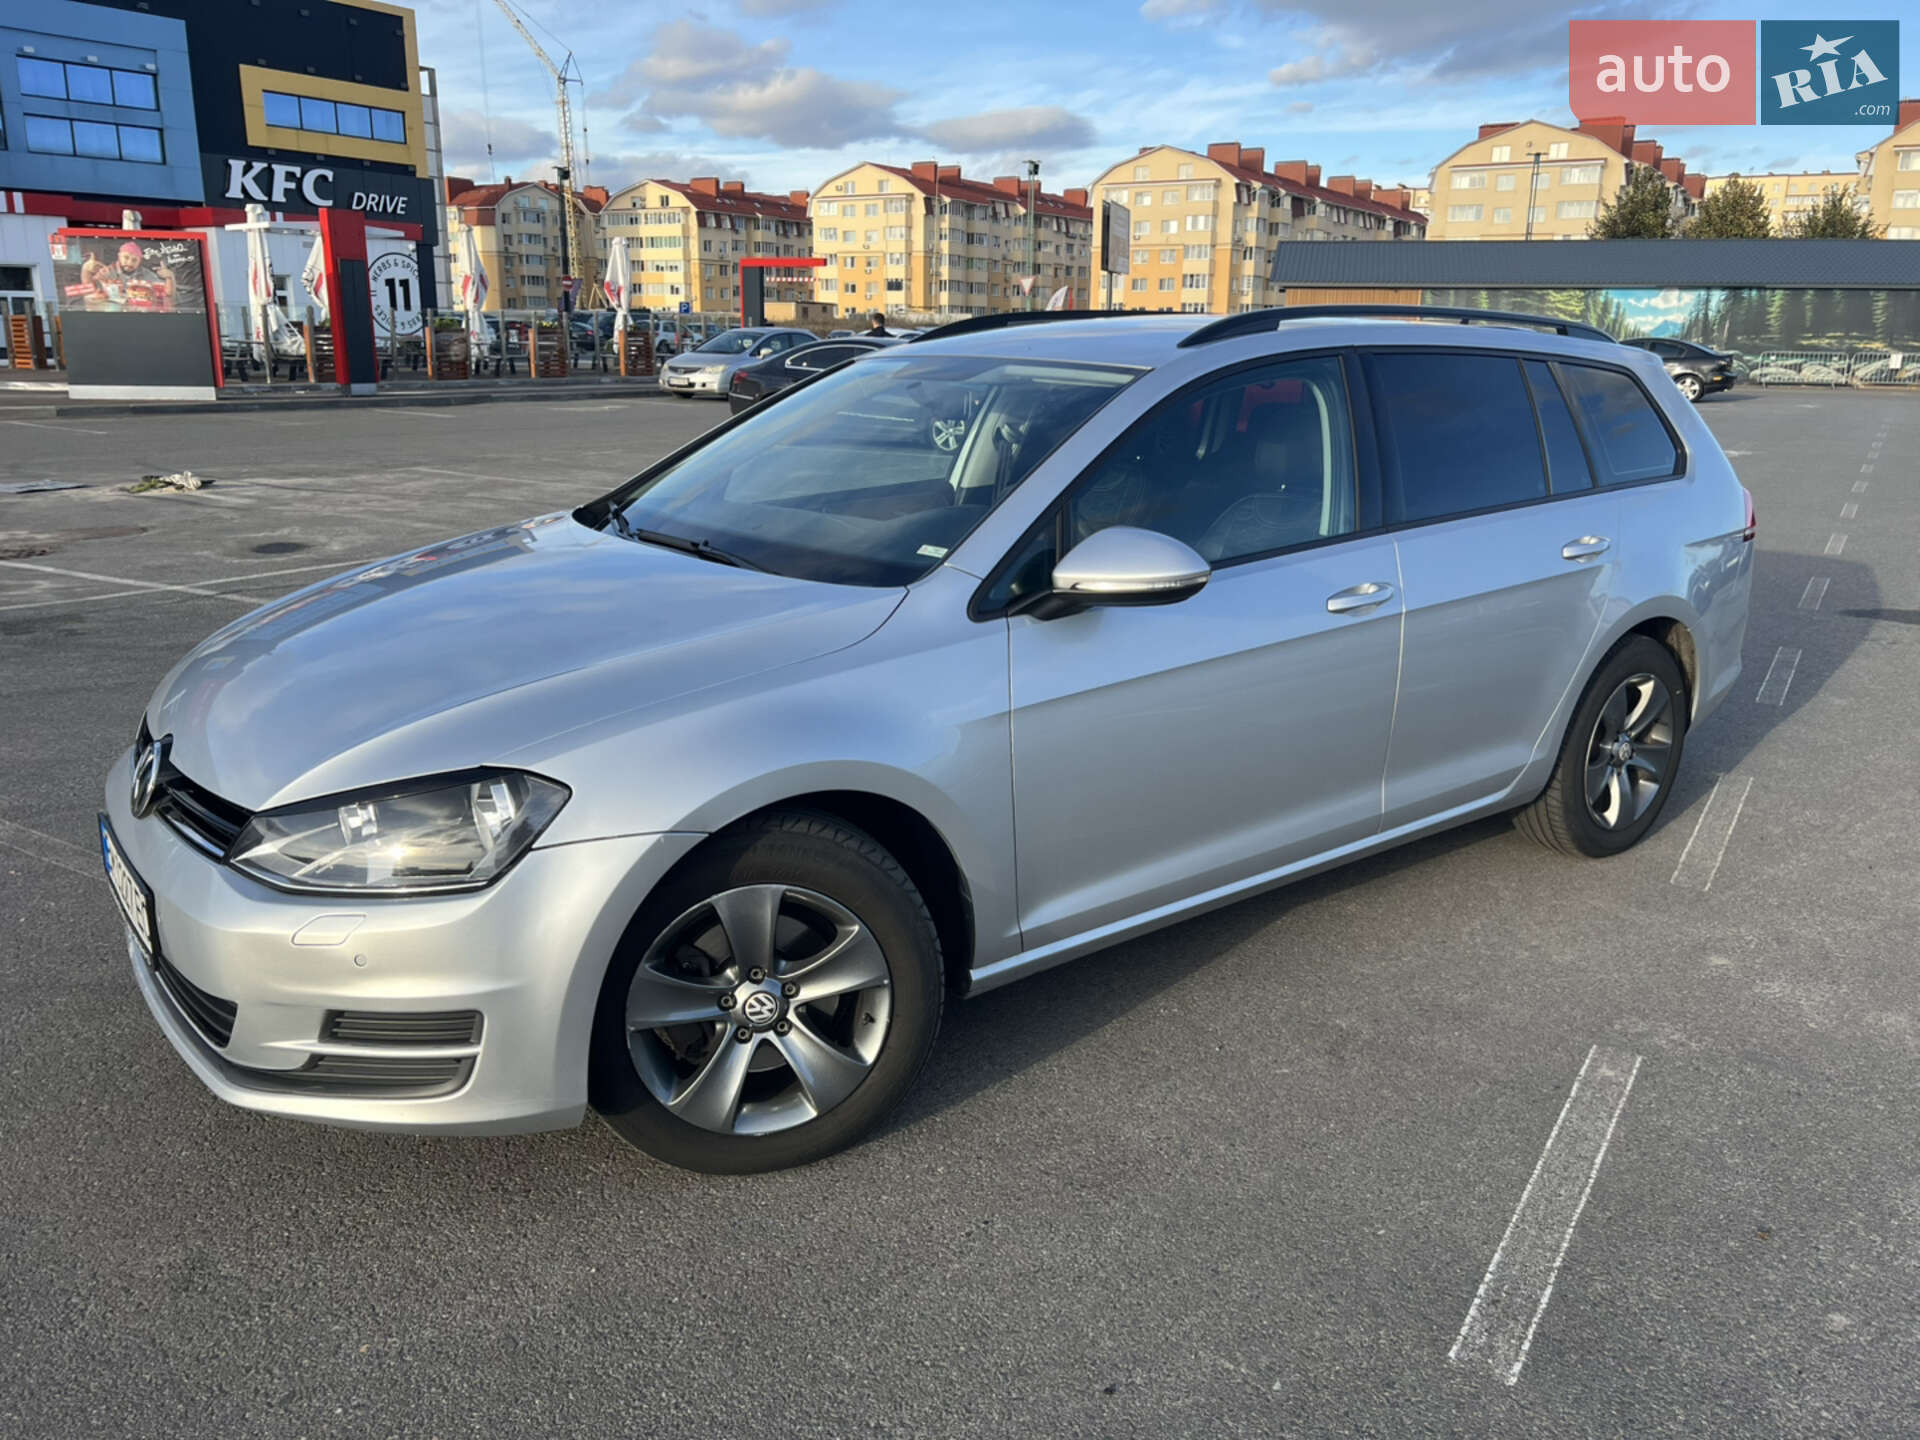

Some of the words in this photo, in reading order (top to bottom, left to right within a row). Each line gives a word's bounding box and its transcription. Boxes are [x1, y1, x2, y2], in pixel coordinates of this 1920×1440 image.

[225, 159, 334, 207] KFC
[351, 191, 408, 215] DRIVE
[372, 259, 391, 282] HERBS
[384, 278, 411, 311] 11
